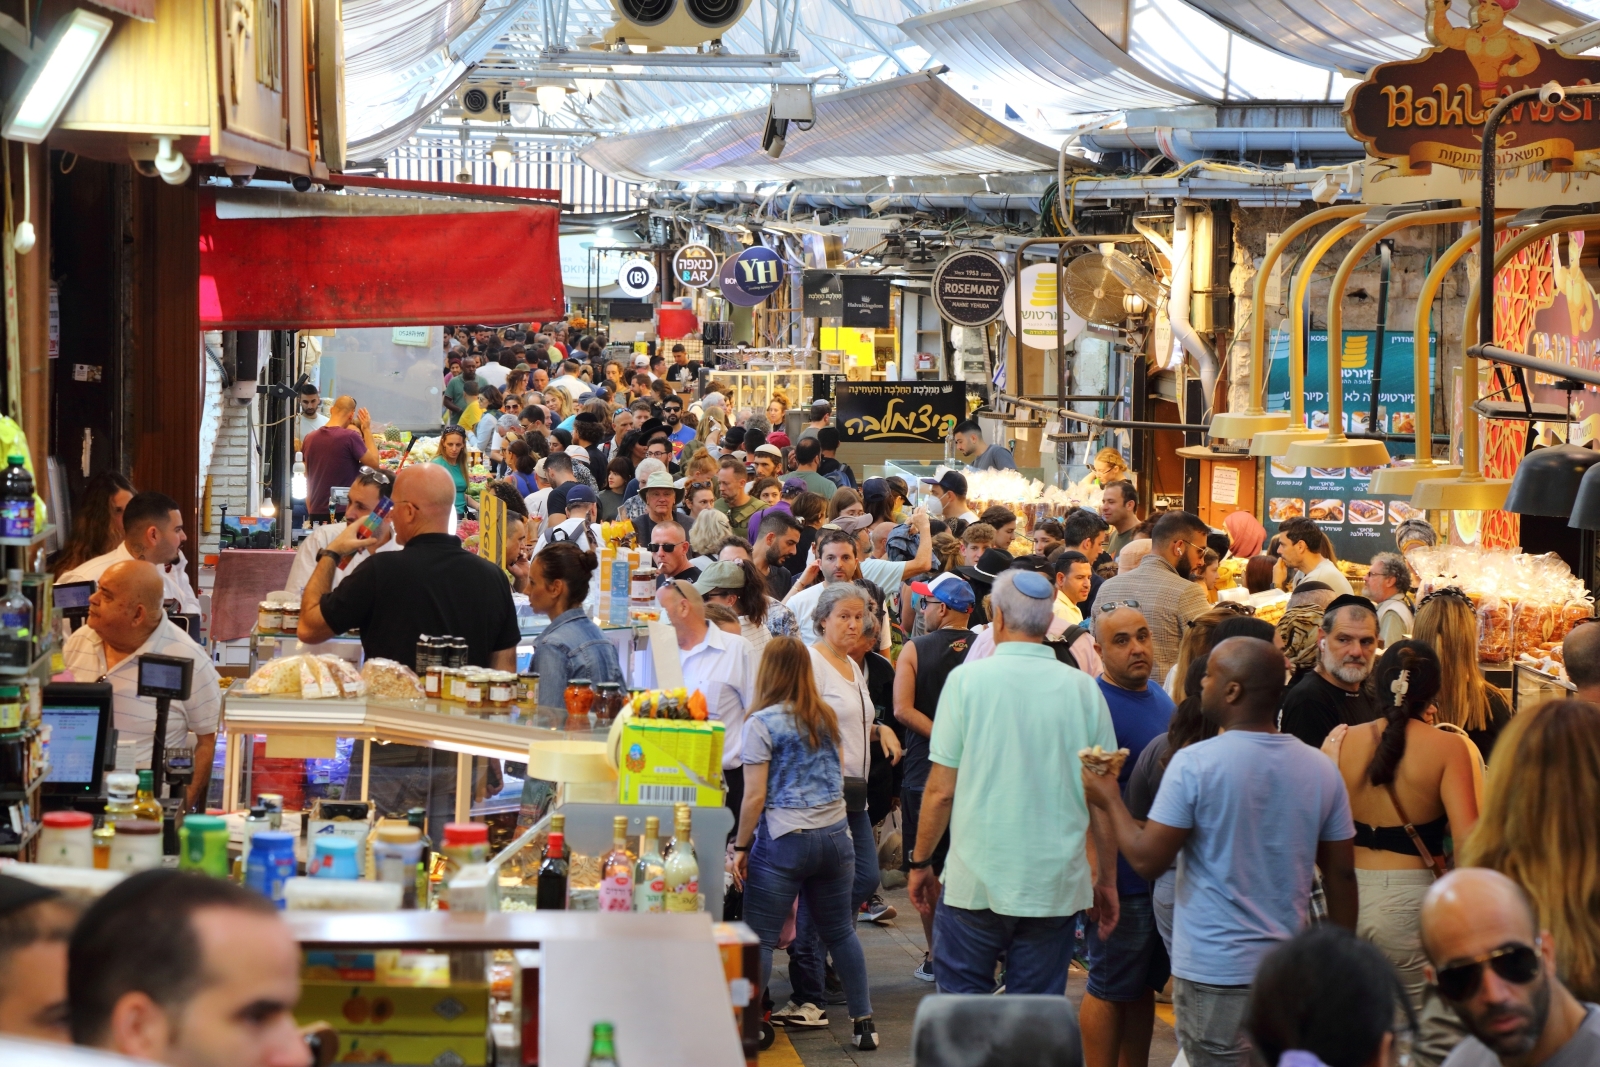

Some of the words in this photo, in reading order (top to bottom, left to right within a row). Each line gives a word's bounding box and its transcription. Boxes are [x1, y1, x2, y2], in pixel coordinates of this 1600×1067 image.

[679, 259, 713, 270] כנאפה
[682, 270, 708, 282] BAR
[738, 258, 779, 284] YH
[944, 283, 1000, 296] ROSEMARY
[1340, 369, 1374, 382] קיורטו
[1344, 390, 1360, 402] לא
